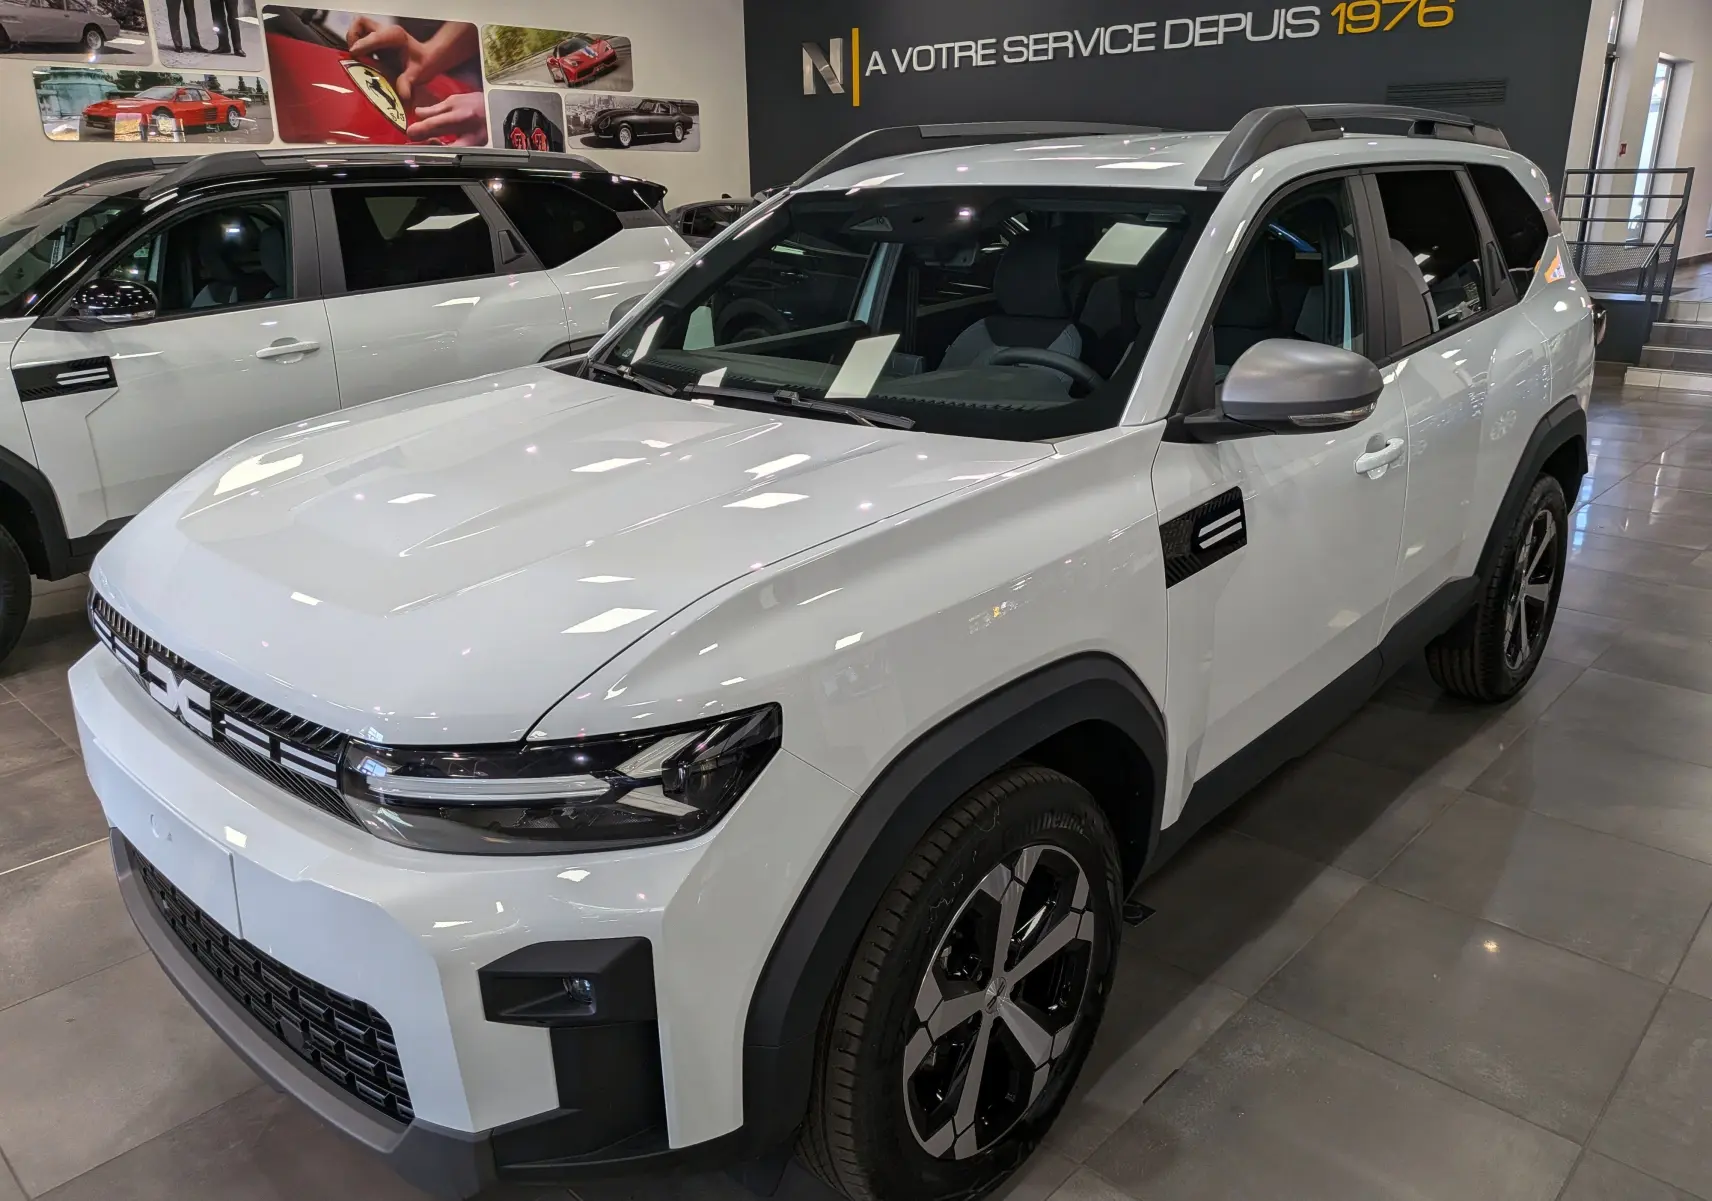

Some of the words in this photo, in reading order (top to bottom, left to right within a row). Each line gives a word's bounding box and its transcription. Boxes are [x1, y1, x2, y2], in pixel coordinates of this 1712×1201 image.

[802, 37, 844, 95] N
[865, 50, 888, 77] A
[891, 38, 997, 73] VOTRE
[1003, 21, 1157, 64] SERVICE
[1163, 5, 1321, 50] DEPUIS
[1330, 0, 1454, 35] 1976
